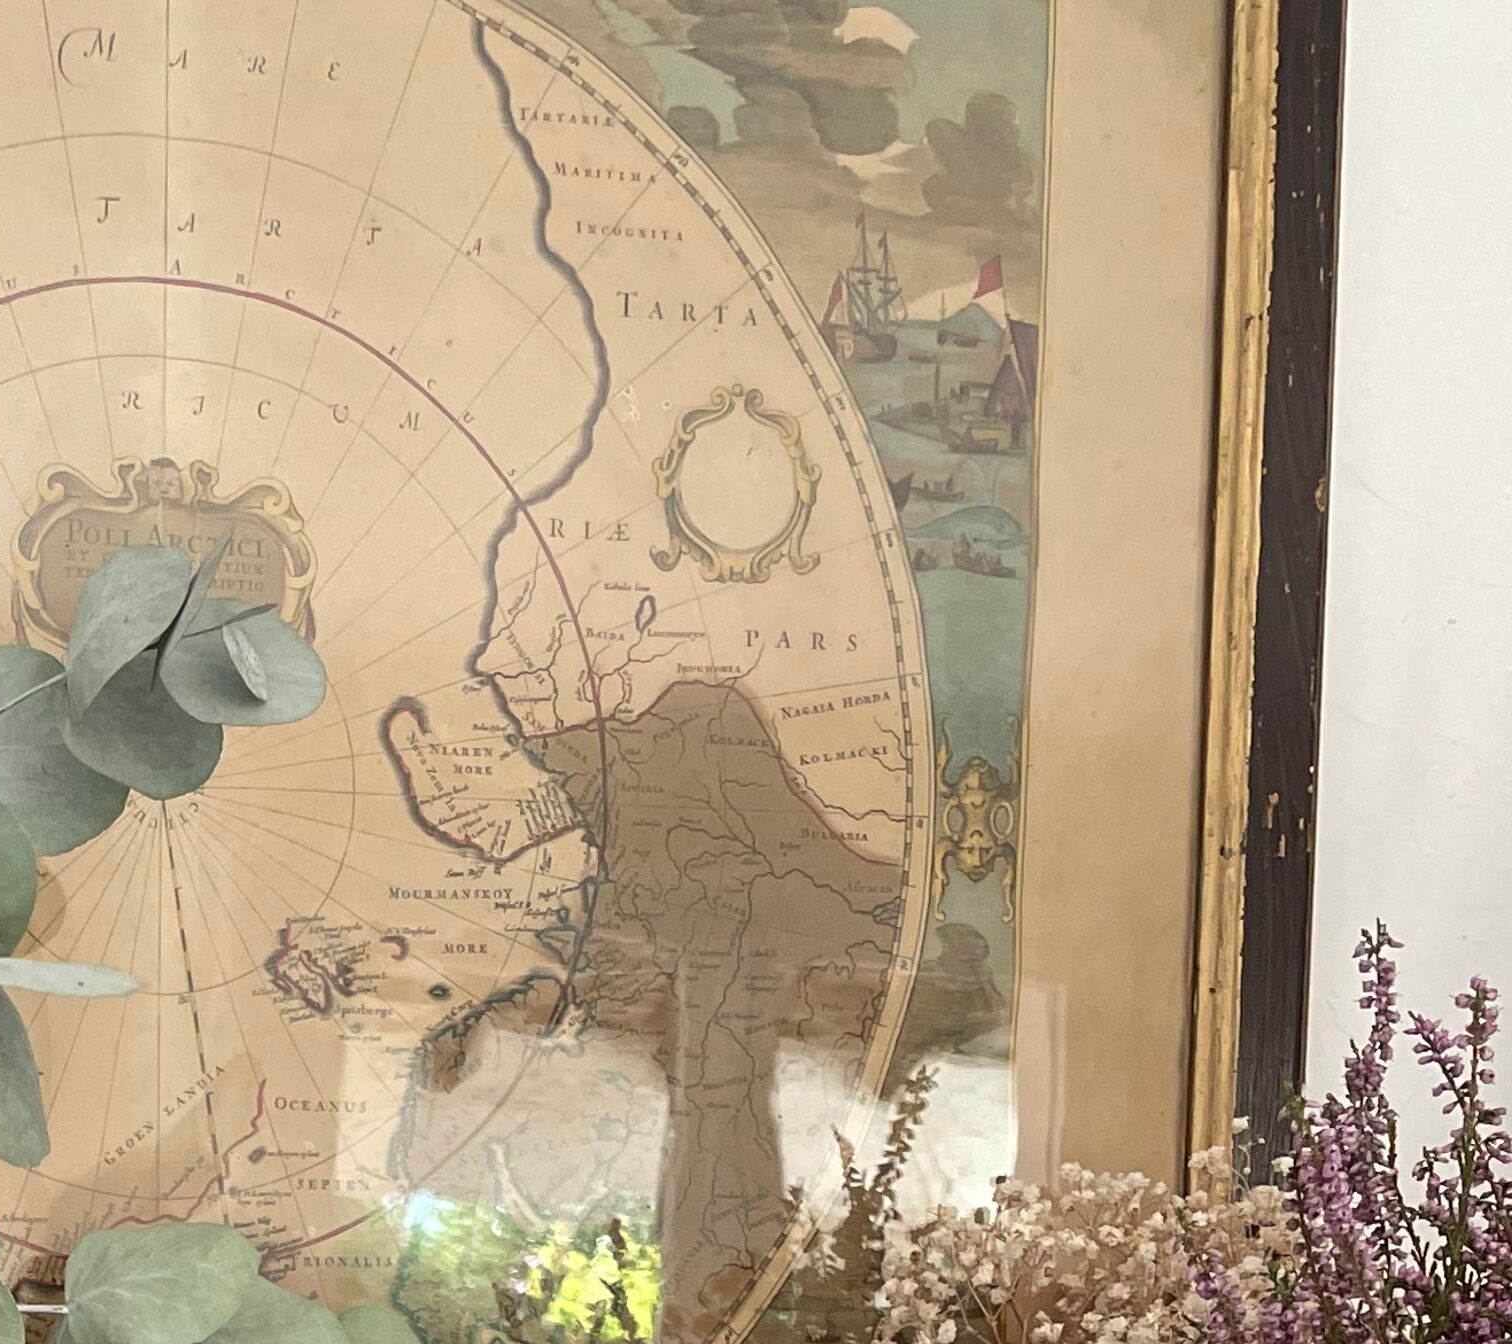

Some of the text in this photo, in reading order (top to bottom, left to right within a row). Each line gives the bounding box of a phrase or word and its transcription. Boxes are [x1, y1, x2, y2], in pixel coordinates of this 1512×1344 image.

[575, 220, 684, 242] INCOGNITA
[744, 628, 859, 653] PARS
[452, 765, 494, 777] MORE
[441, 942, 488, 955] MORE
[274, 1096, 368, 1115] OCEANUS
